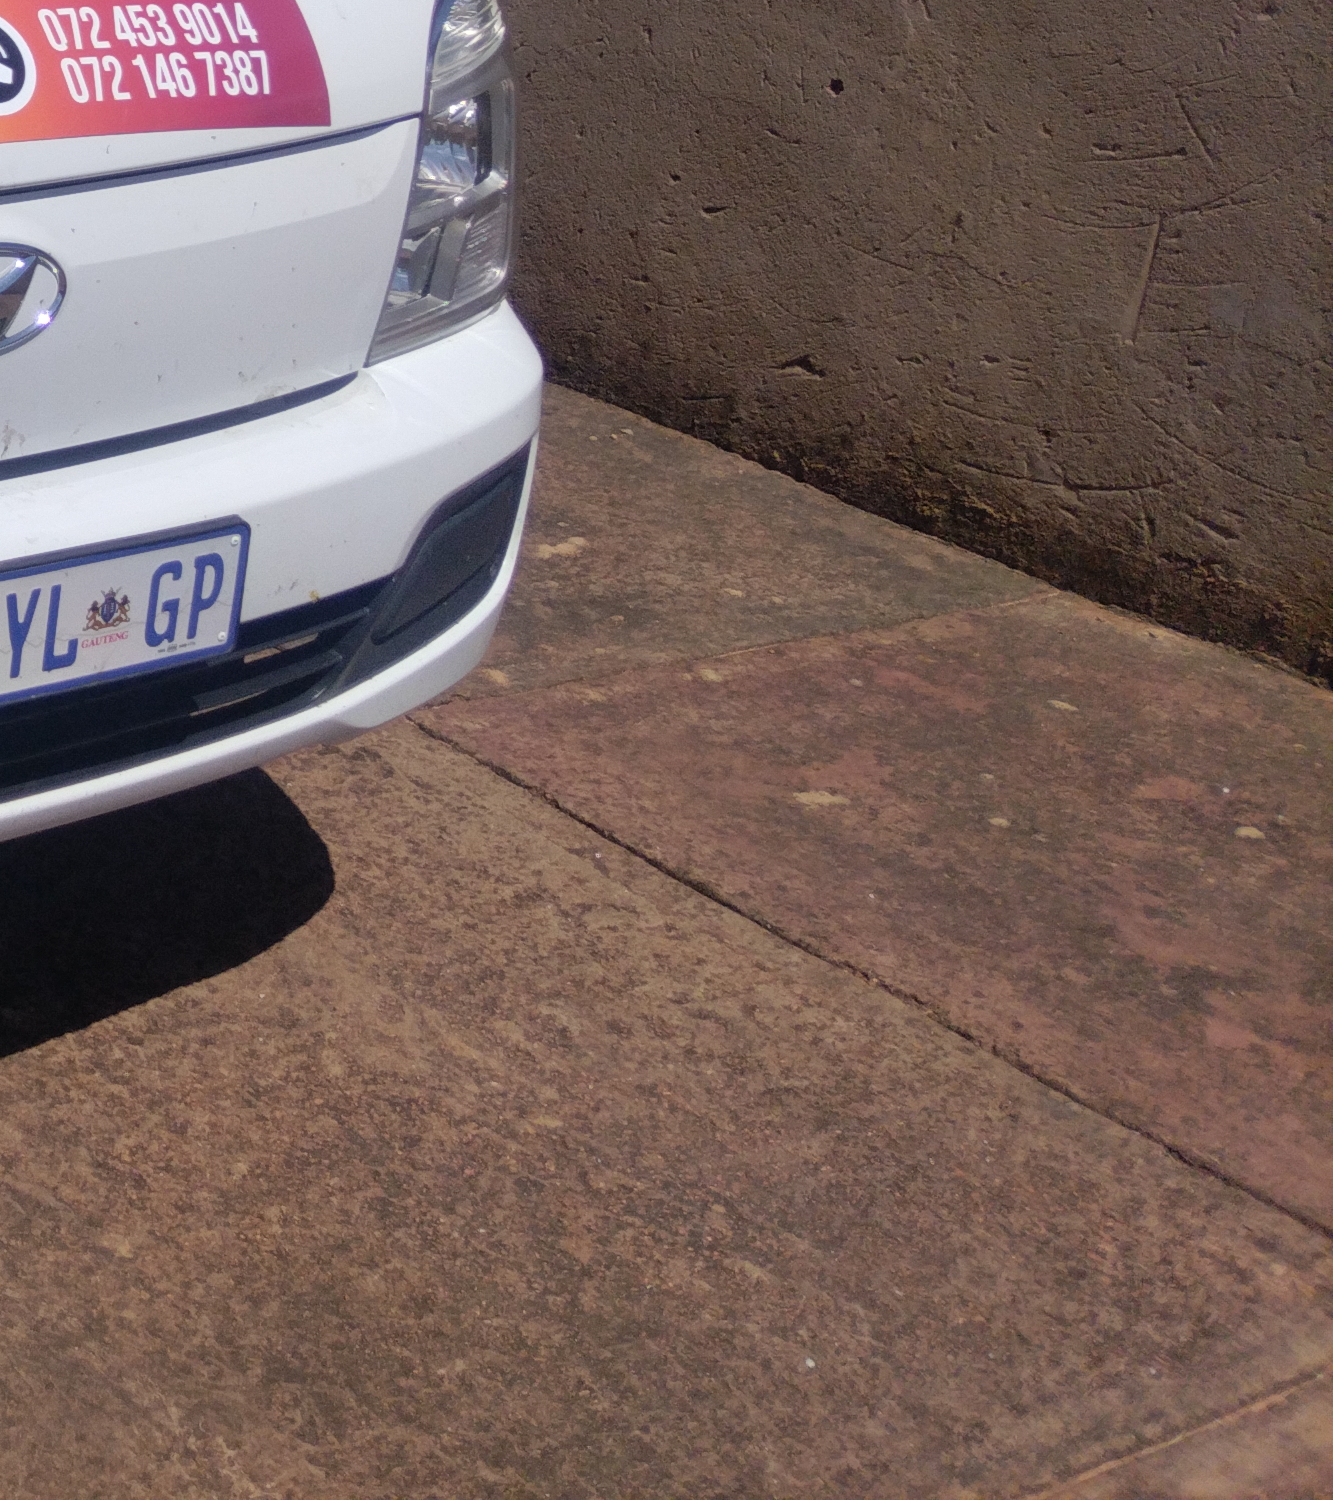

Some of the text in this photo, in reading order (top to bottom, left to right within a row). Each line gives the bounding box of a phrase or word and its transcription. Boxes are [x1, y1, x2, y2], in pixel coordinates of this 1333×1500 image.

[37, 2, 258, 51] 072 453 9014
[60, 50, 270, 104] 072 146 7387
[6, 583, 78, 679] YL
[144, 552, 225, 648] GP
[80, 630, 130, 649] GAUTENG
